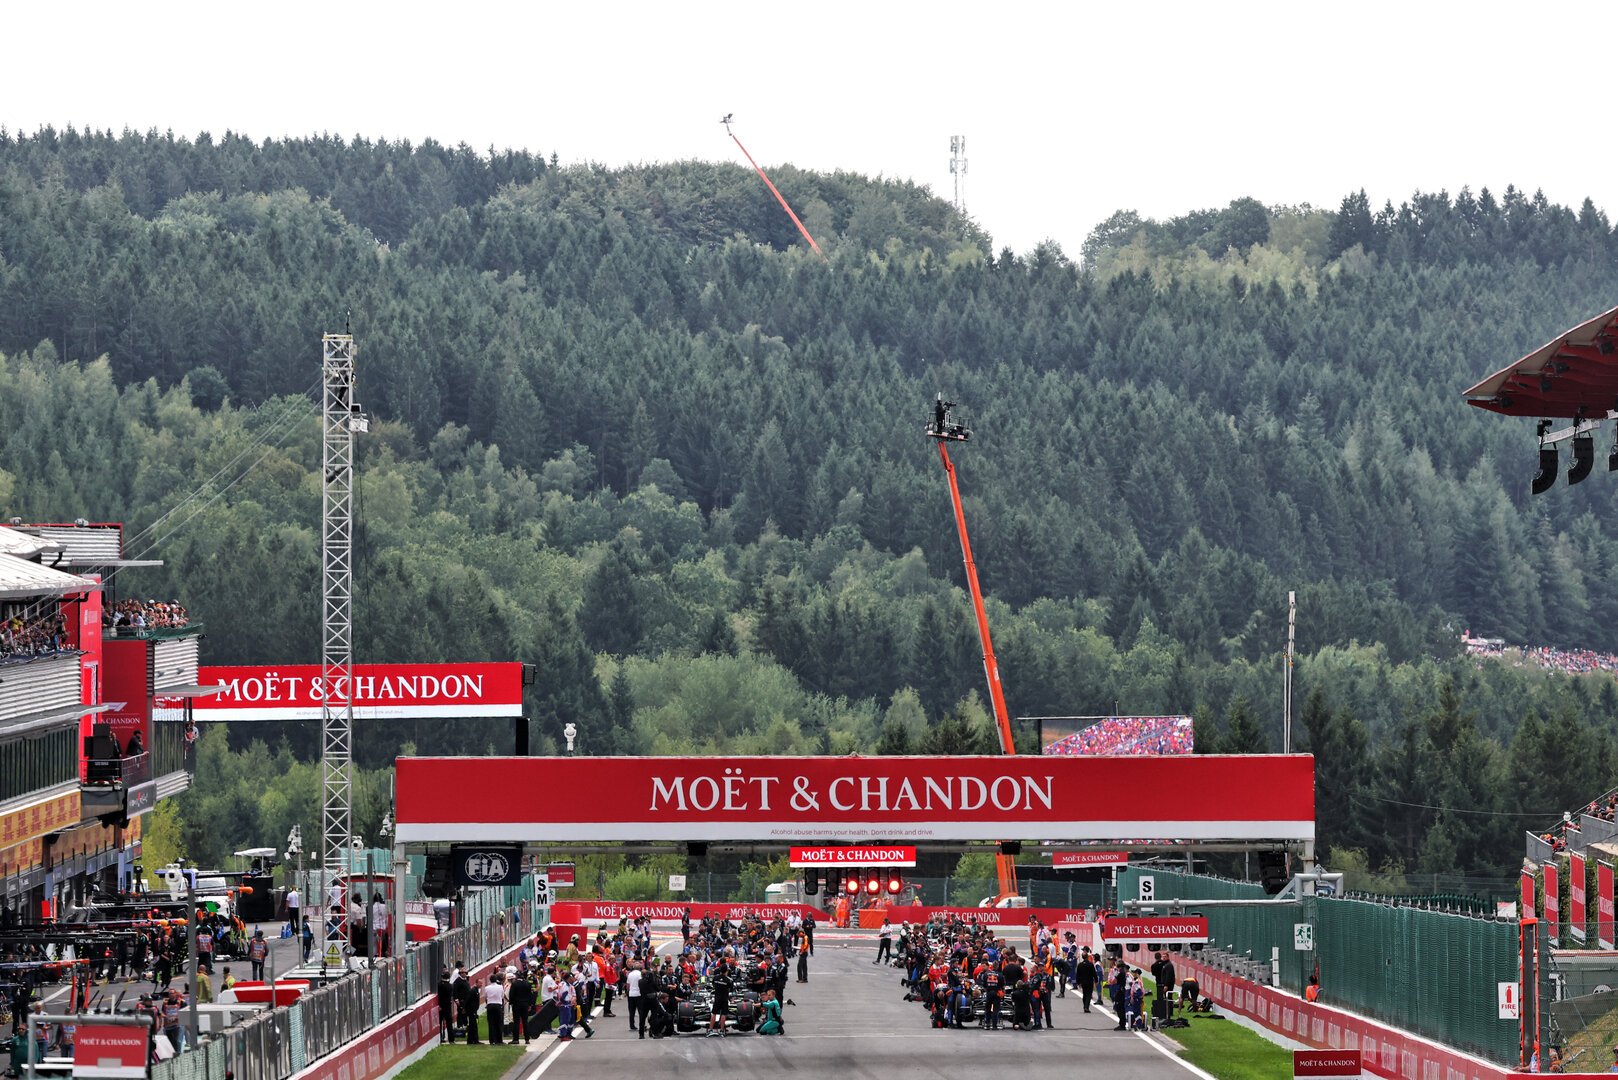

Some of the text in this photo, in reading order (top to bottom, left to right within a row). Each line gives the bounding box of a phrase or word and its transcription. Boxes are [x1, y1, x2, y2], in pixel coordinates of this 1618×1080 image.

[216, 672, 483, 701] MOËT & CHANDON
[649, 768, 1054, 812] MOËT & CHANDON
[801, 848, 904, 860] MOËT & CHANDON
[538, 880, 546, 891] S
[1142, 881, 1152, 892] S
[537, 894, 547, 904] M
[595, 904, 684, 917] MOËT & CHANDON
[1114, 924, 1200, 934] MOËT & CHANDON
